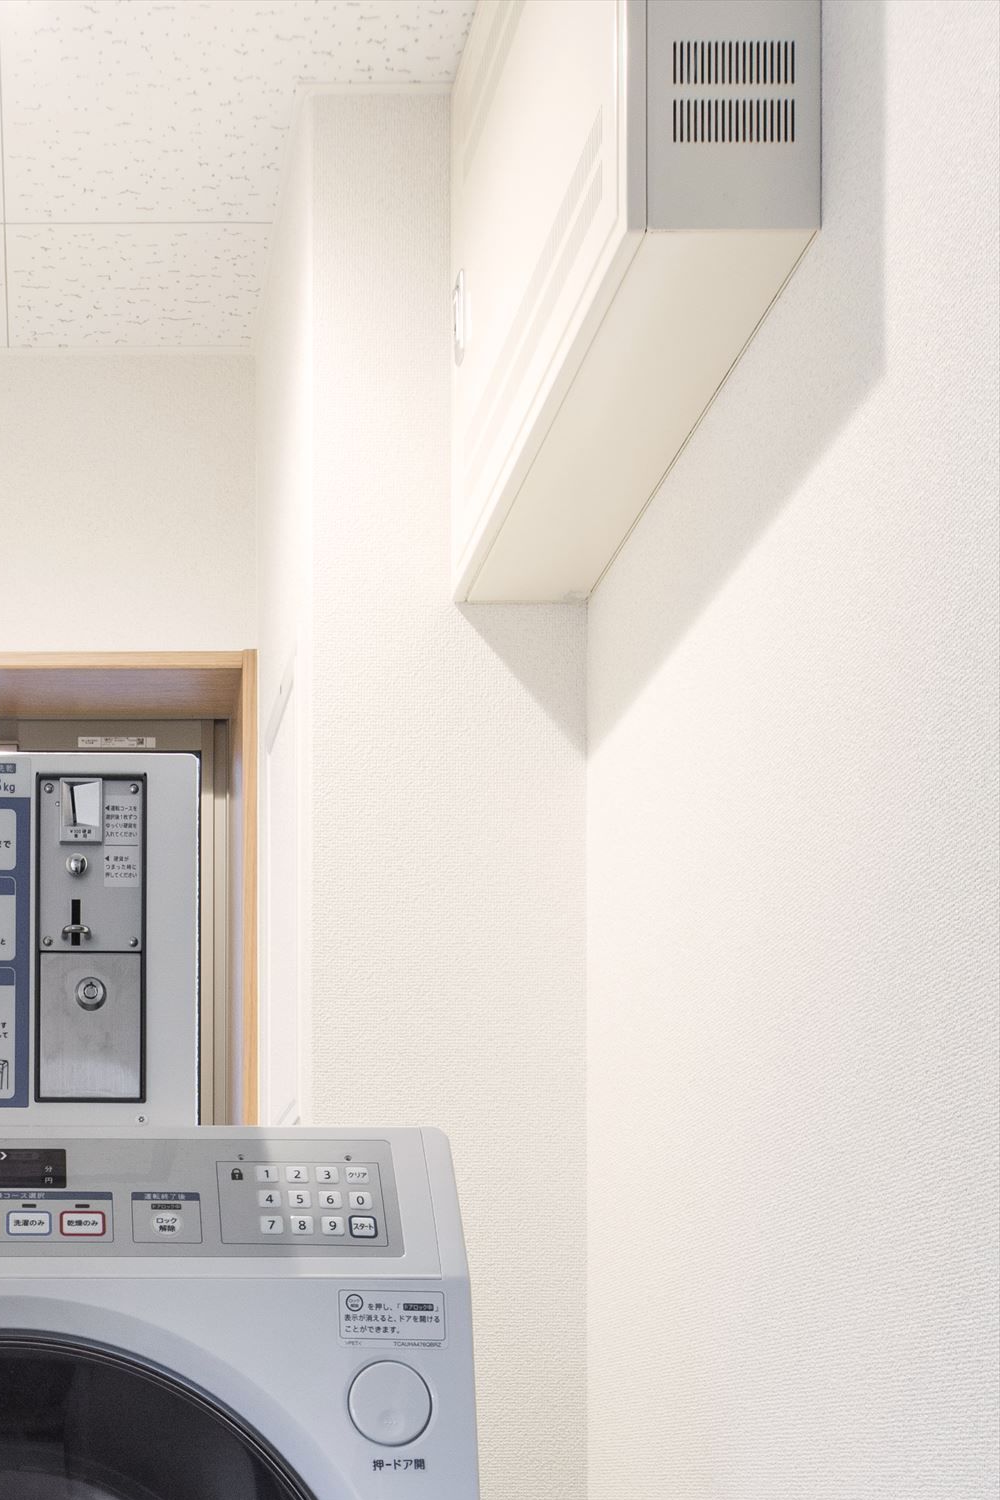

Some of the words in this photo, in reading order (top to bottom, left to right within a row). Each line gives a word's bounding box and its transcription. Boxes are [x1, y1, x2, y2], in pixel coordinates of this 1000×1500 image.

[265, 1170, 269, 1178] 1
[324, 1171, 331, 1179] 3
[266, 1195, 273, 1203] 4
[297, 1195, 303, 1203] 5
[327, 1196, 334, 1204] 6
[357, 1196, 364, 1205] 0
[268, 1220, 275, 1229] 7
[299, 1221, 306, 1230] 8
[329, 1221, 336, 1230] 9
[345, 1314, 440, 1323] 表示が消えると、ドアを開ける
